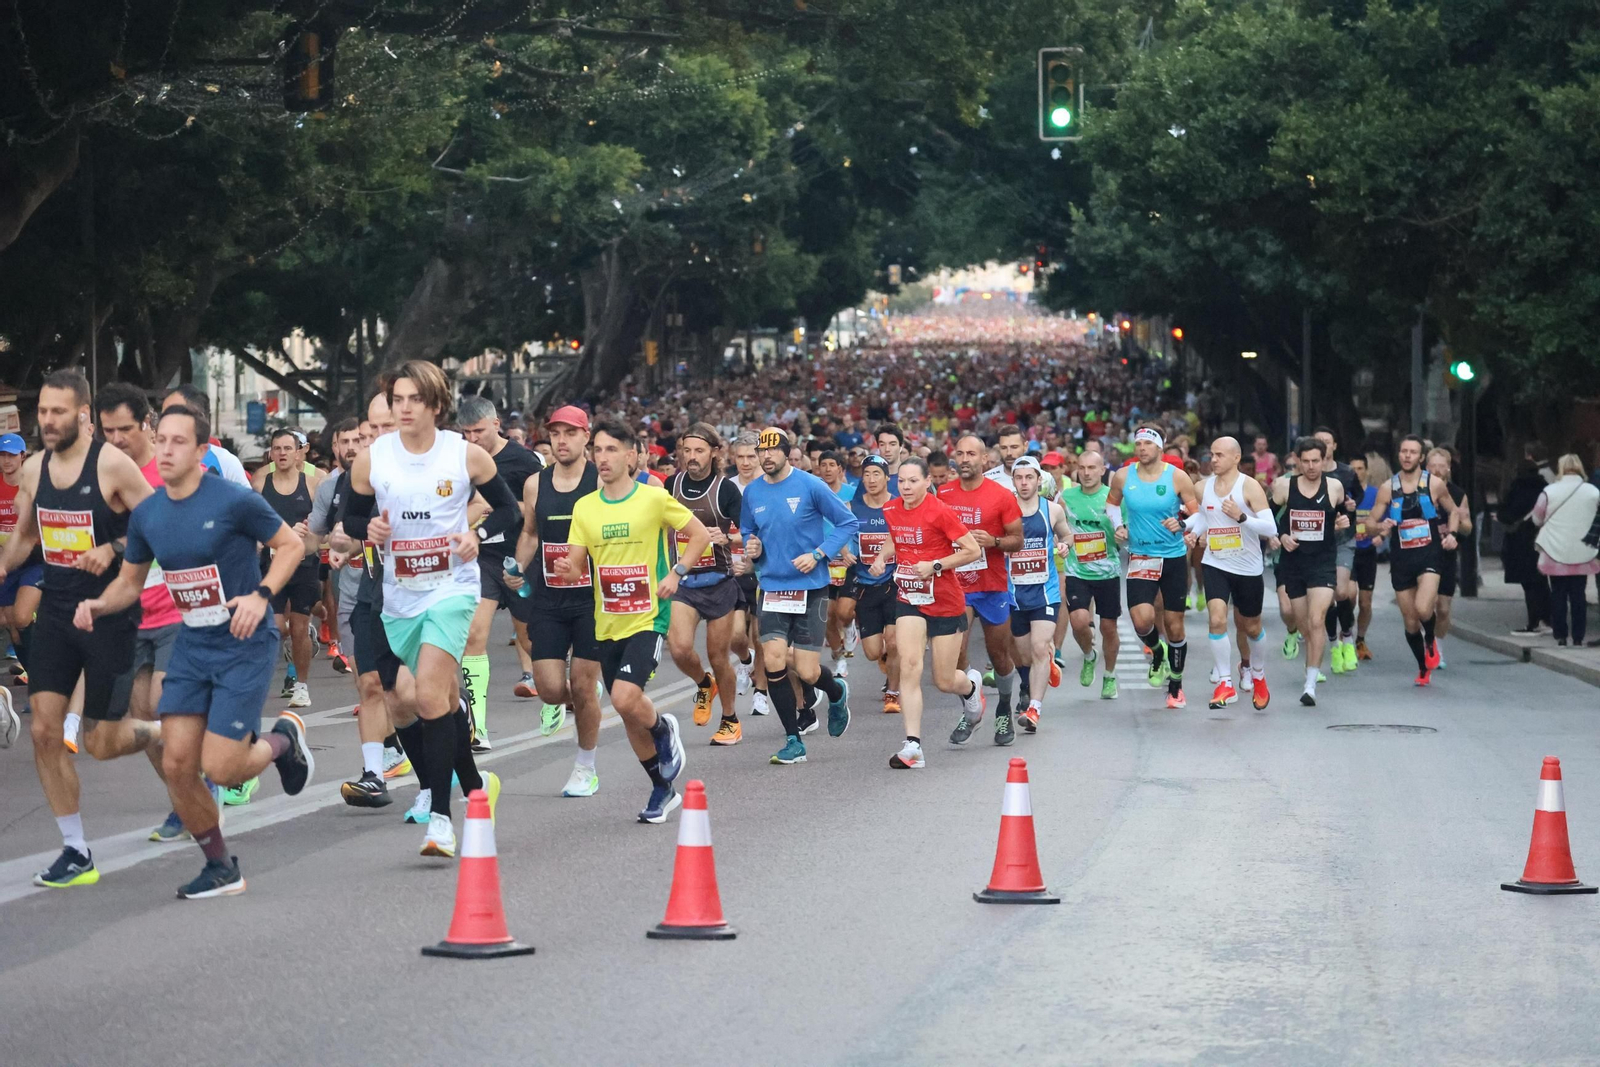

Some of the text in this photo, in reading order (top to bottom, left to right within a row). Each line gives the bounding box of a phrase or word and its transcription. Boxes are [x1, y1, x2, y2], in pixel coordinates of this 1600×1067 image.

[49, 513, 88, 524] GENERALI
[401, 510, 431, 520] AVIS
[870, 517, 885, 526] DNB
[1297, 520, 1317, 528] 10516
[603, 523, 628, 532] MANN
[603, 530, 628, 538] FILTER
[405, 538, 446, 550] GENERALI
[552, 545, 570, 553] GENE
[404, 555, 440, 568] 13488
[1017, 561, 1040, 570] 11114
[174, 569, 214, 581] GENERALI
[609, 567, 645, 576] GENERALI
[610, 583, 636, 593] 5543
[900, 580, 924, 589] 10105
[177, 588, 211, 603] 15554
